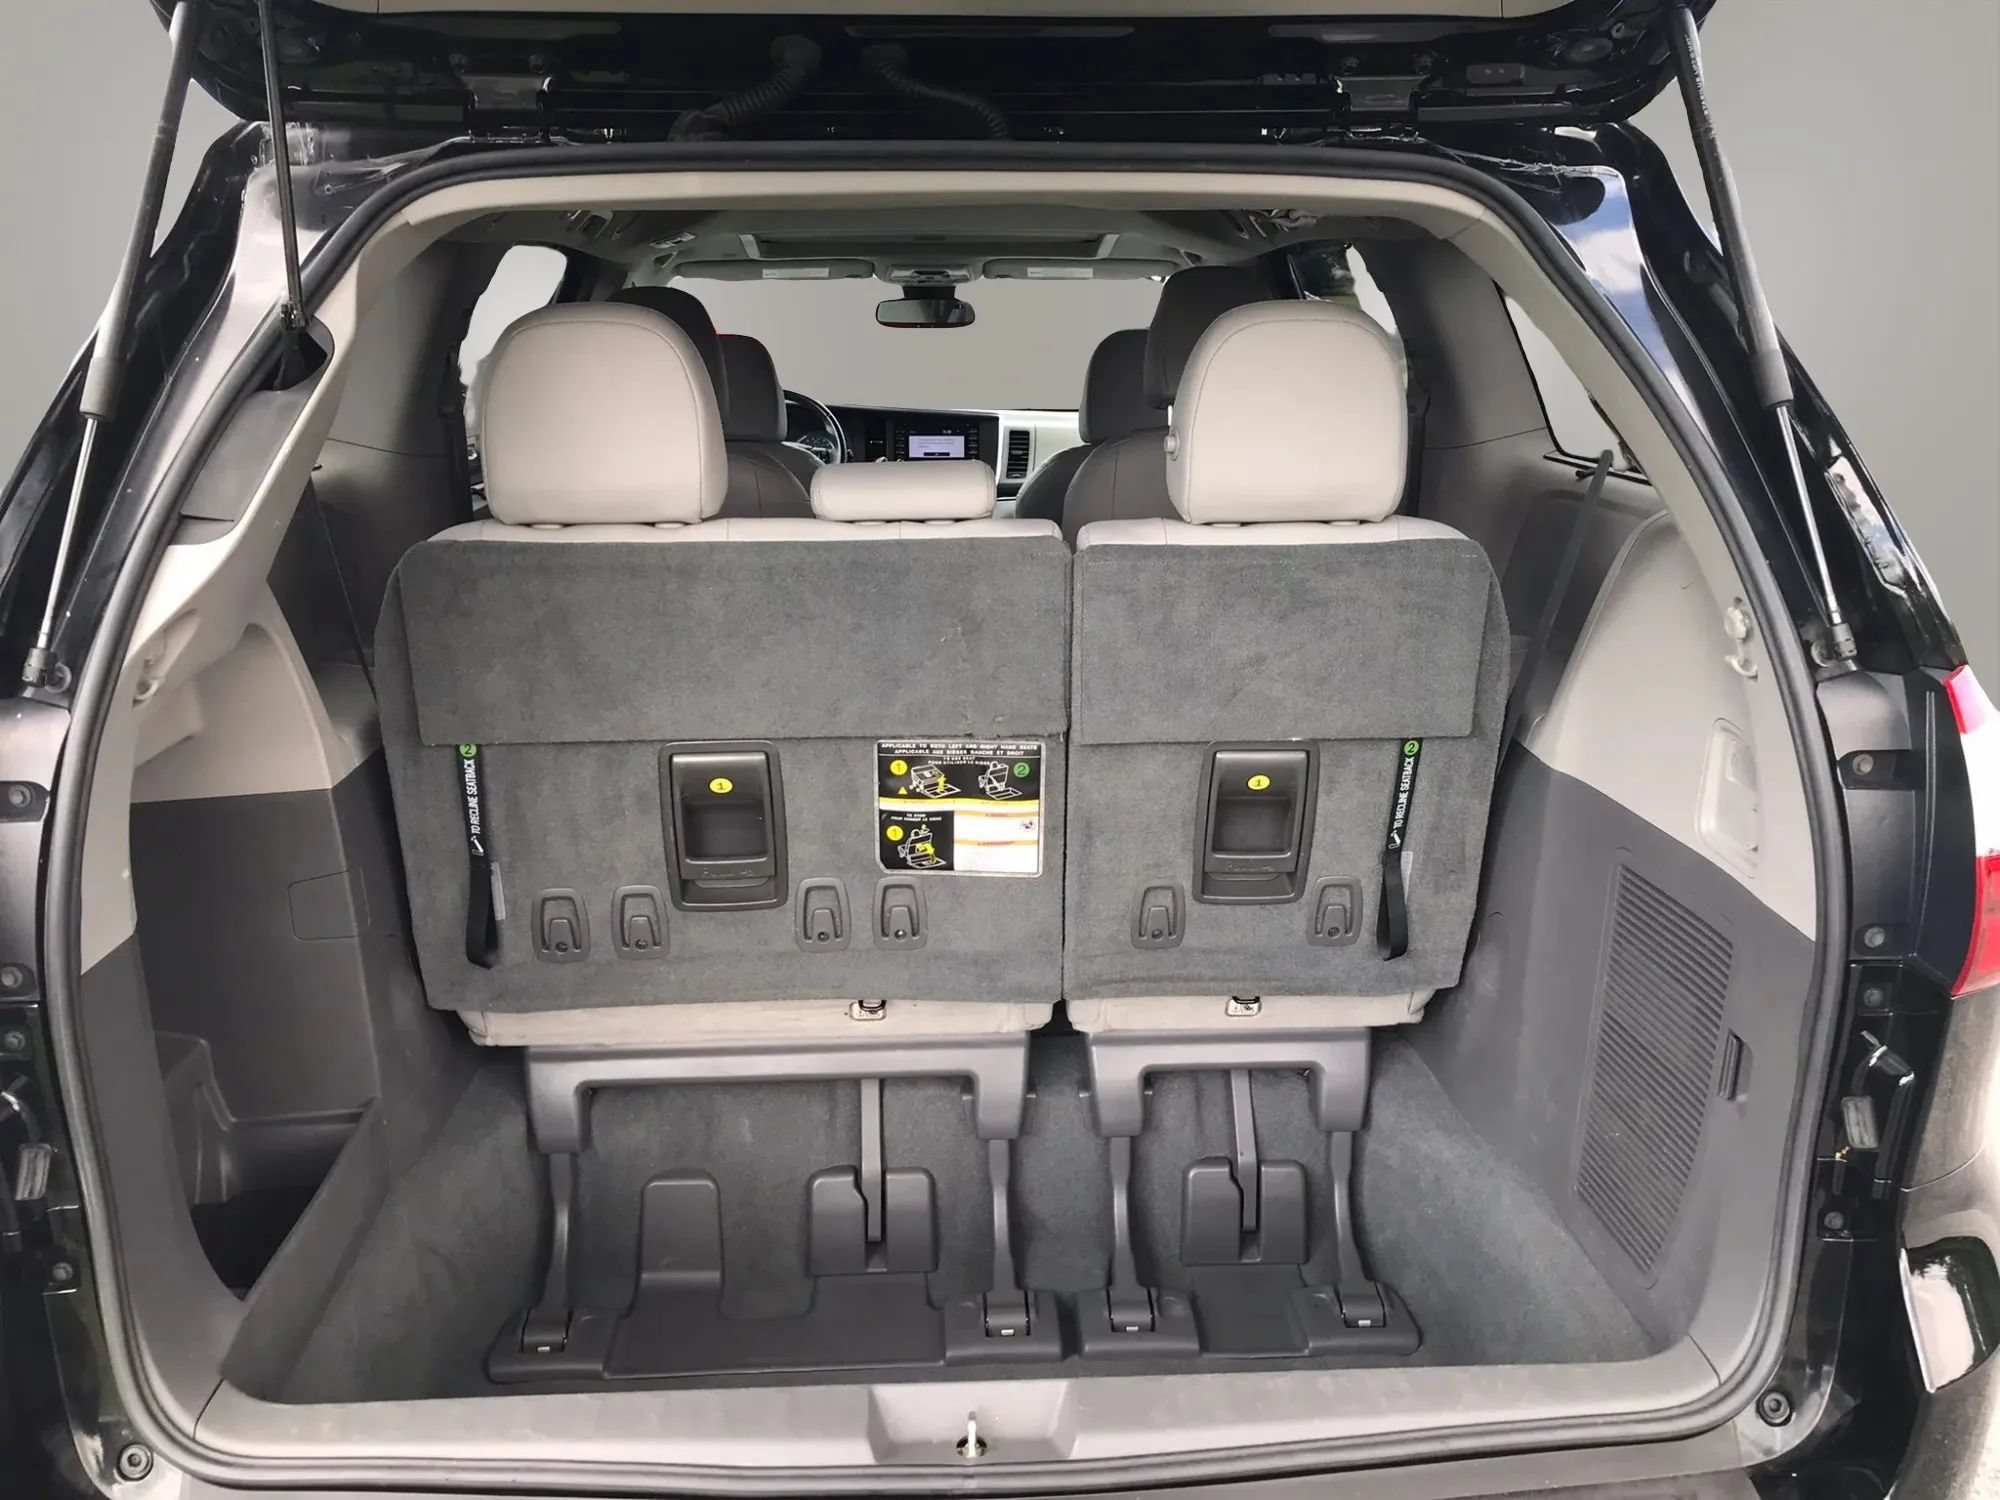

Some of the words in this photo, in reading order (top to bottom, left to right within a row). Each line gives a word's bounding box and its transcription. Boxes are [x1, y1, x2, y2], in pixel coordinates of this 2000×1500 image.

[463, 758, 478, 795] SEATBACK
[1399, 756, 1415, 791] SEATBACK
[467, 795, 480, 825] RECLINE
[1394, 791, 1409, 820] RECLINE
[470, 824, 481, 834] TO
[1393, 819, 1404, 829] TO
